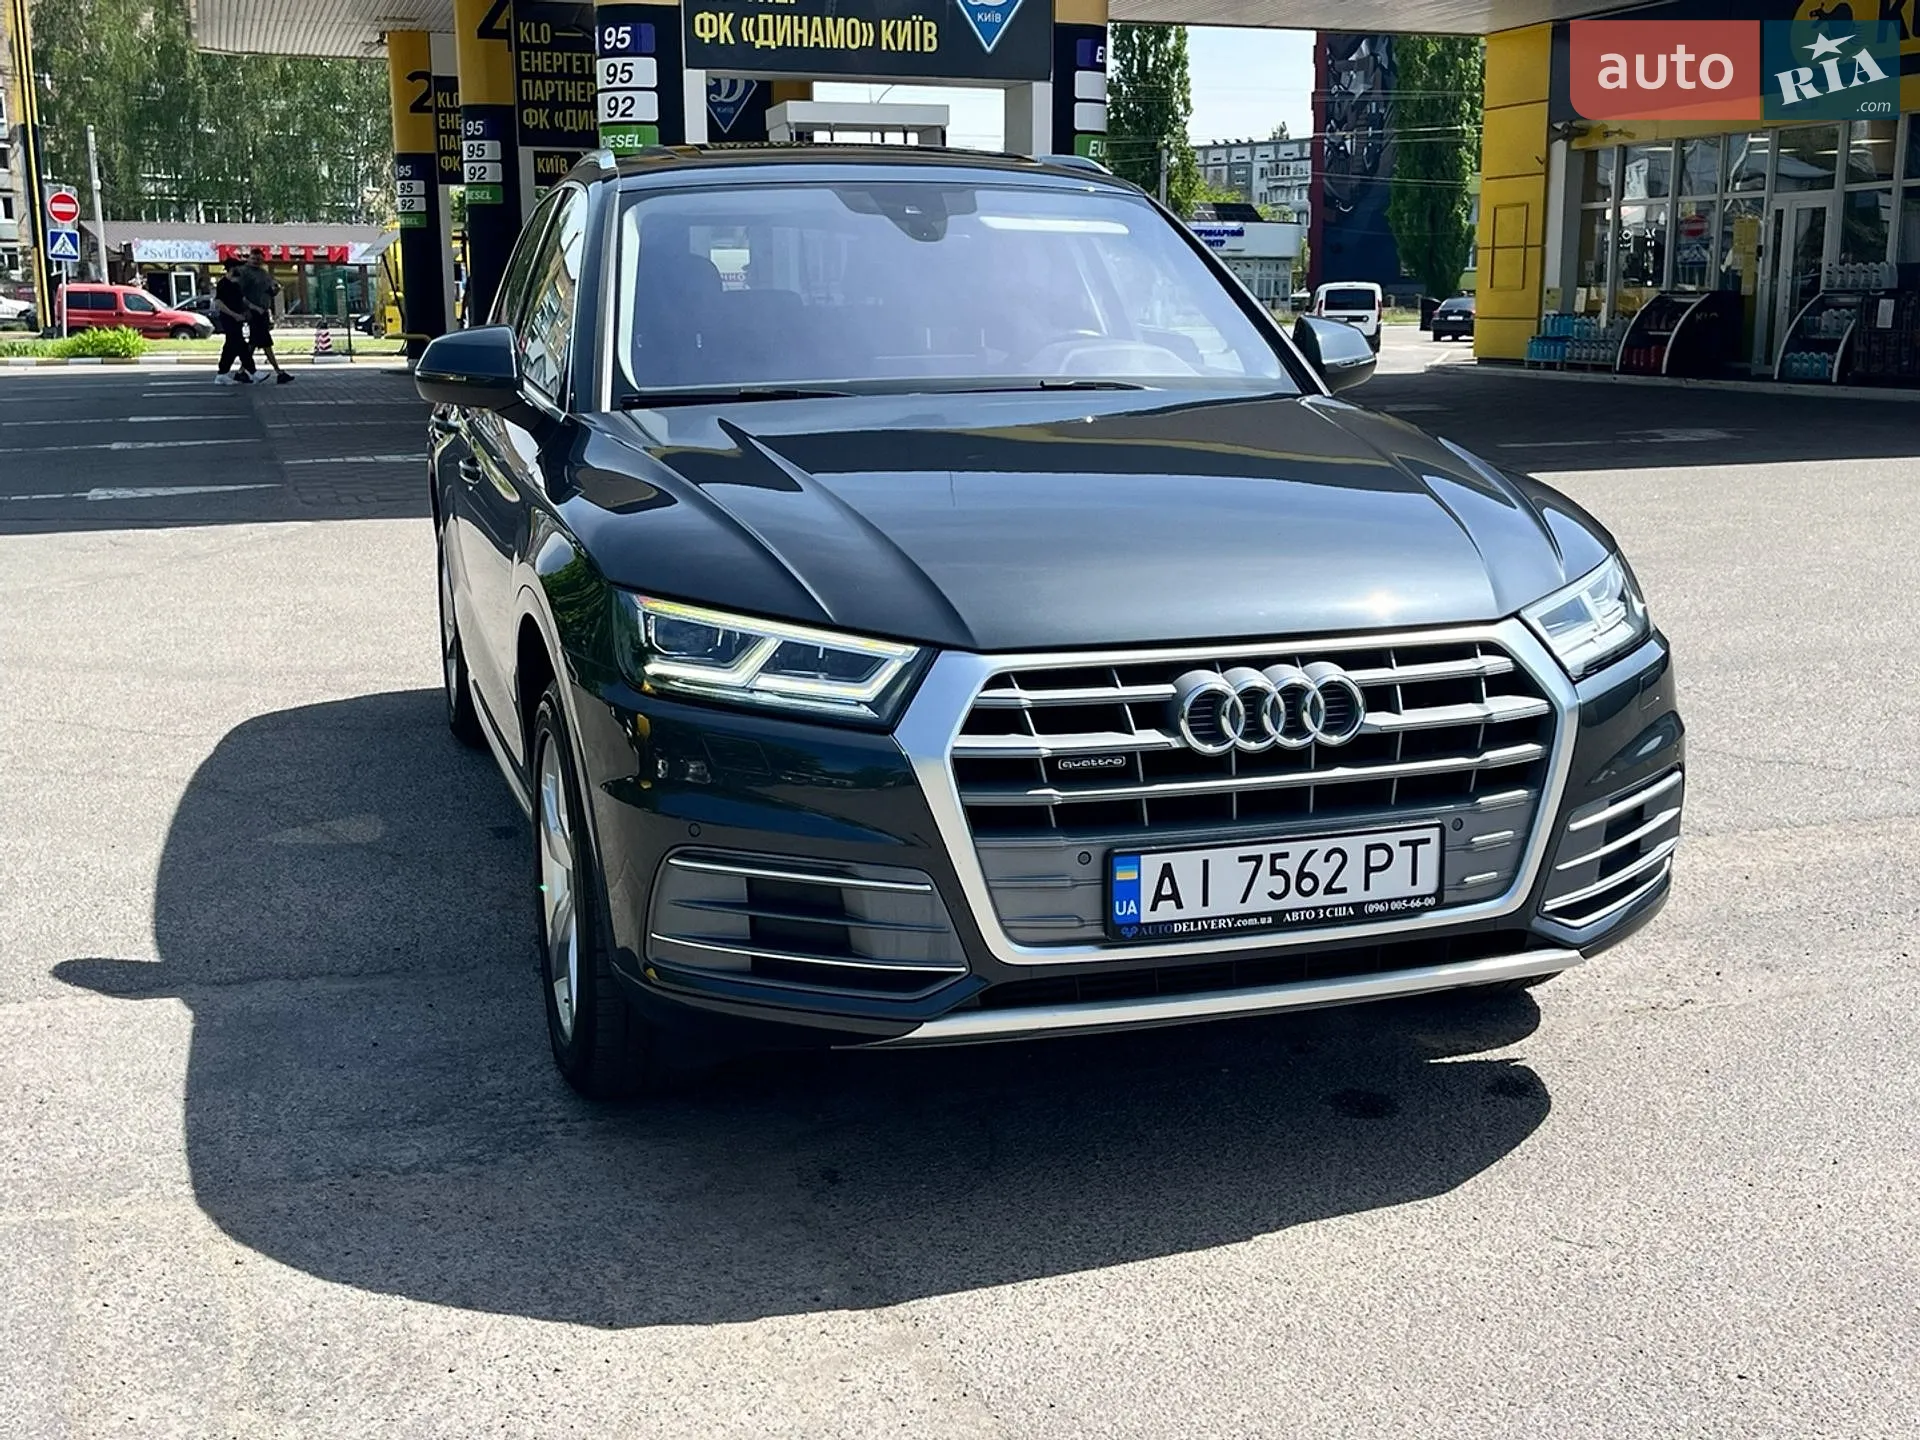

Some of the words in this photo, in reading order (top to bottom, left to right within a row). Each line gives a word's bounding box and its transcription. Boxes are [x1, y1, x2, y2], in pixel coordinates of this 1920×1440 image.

[976, 12, 1002, 23] КИЇВ
[519, 21, 551, 44] KLO
[603, 26, 632, 50] 95
[694, 11, 736, 45] ФК
[741, 13, 875, 50] «ДИНАМО»
[881, 15, 939, 52] КИЇВ
[605, 62, 634, 85] 95
[521, 79, 596, 103] ПАРТНЕР
[606, 96, 636, 118] 92
[522, 107, 551, 129] ФК
[466, 120, 485, 136] 95
[601, 134, 644, 148] DIESEL
[466, 143, 486, 159] 95
[440, 155, 461, 171] ФК
[536, 154, 569, 174] КИЇВ
[468, 166, 488, 180] 92
[399, 182, 413, 194] 95
[401, 199, 415, 210] 92
[1061, 757, 1123, 769] quattro
[1149, 858, 1210, 912] AI
[1237, 846, 1349, 905] 7562
[1363, 837, 1432, 893] PT
[1115, 899, 1138, 916] UA
[1283, 909, 1315, 923] АВТО
[1326, 906, 1355, 918] США
[1364, 902, 1389, 915] (096)
